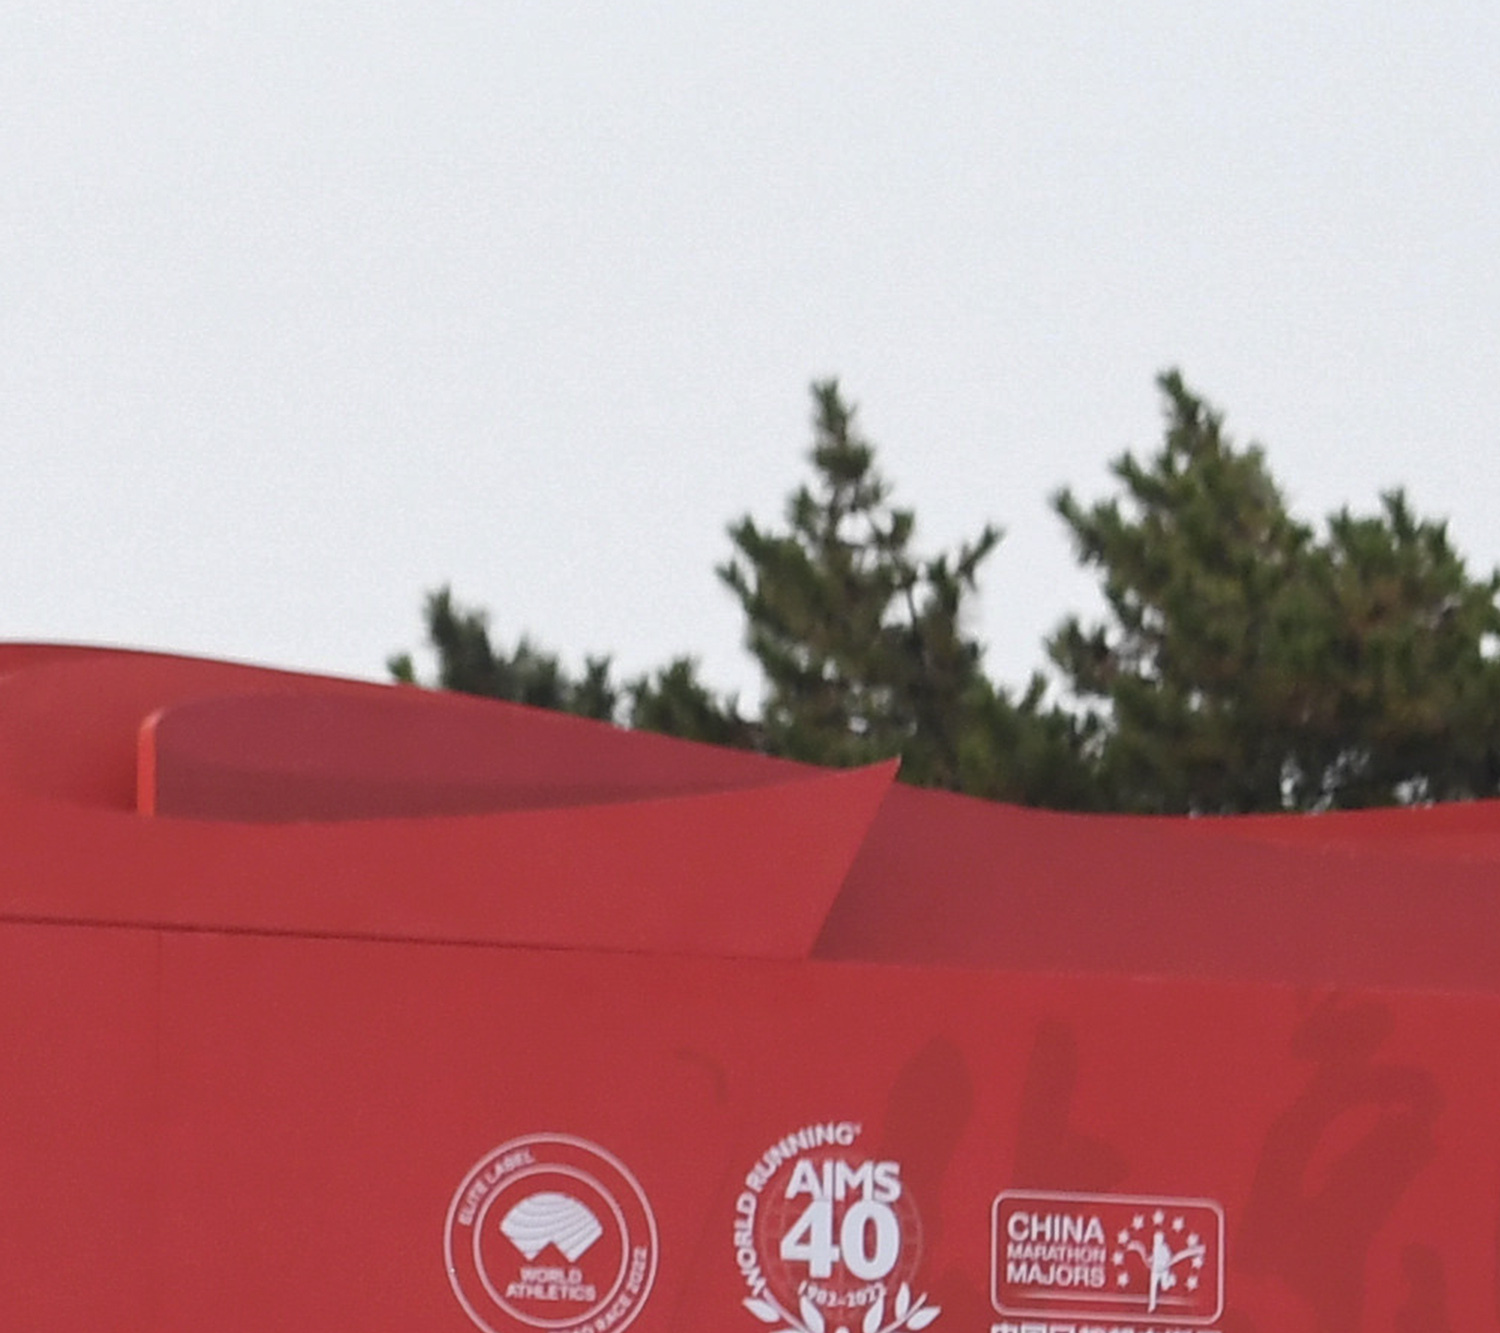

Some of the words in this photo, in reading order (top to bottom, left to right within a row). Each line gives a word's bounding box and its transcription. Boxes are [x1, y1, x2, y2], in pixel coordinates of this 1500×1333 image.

[745, 1121, 856, 1192] RUNNING
[785, 1159, 901, 1203] AIMS
[780, 1201, 900, 1281] 40
[1007, 1211, 1105, 1244] CHINA
[734, 1192, 766, 1297] WORLD
[1007, 1242, 1106, 1264] MARATHON
[505, 1283, 596, 1301] ATHLETICS
[520, 1267, 582, 1284] WORLD
[1007, 1263, 1106, 1288] MAJORS
